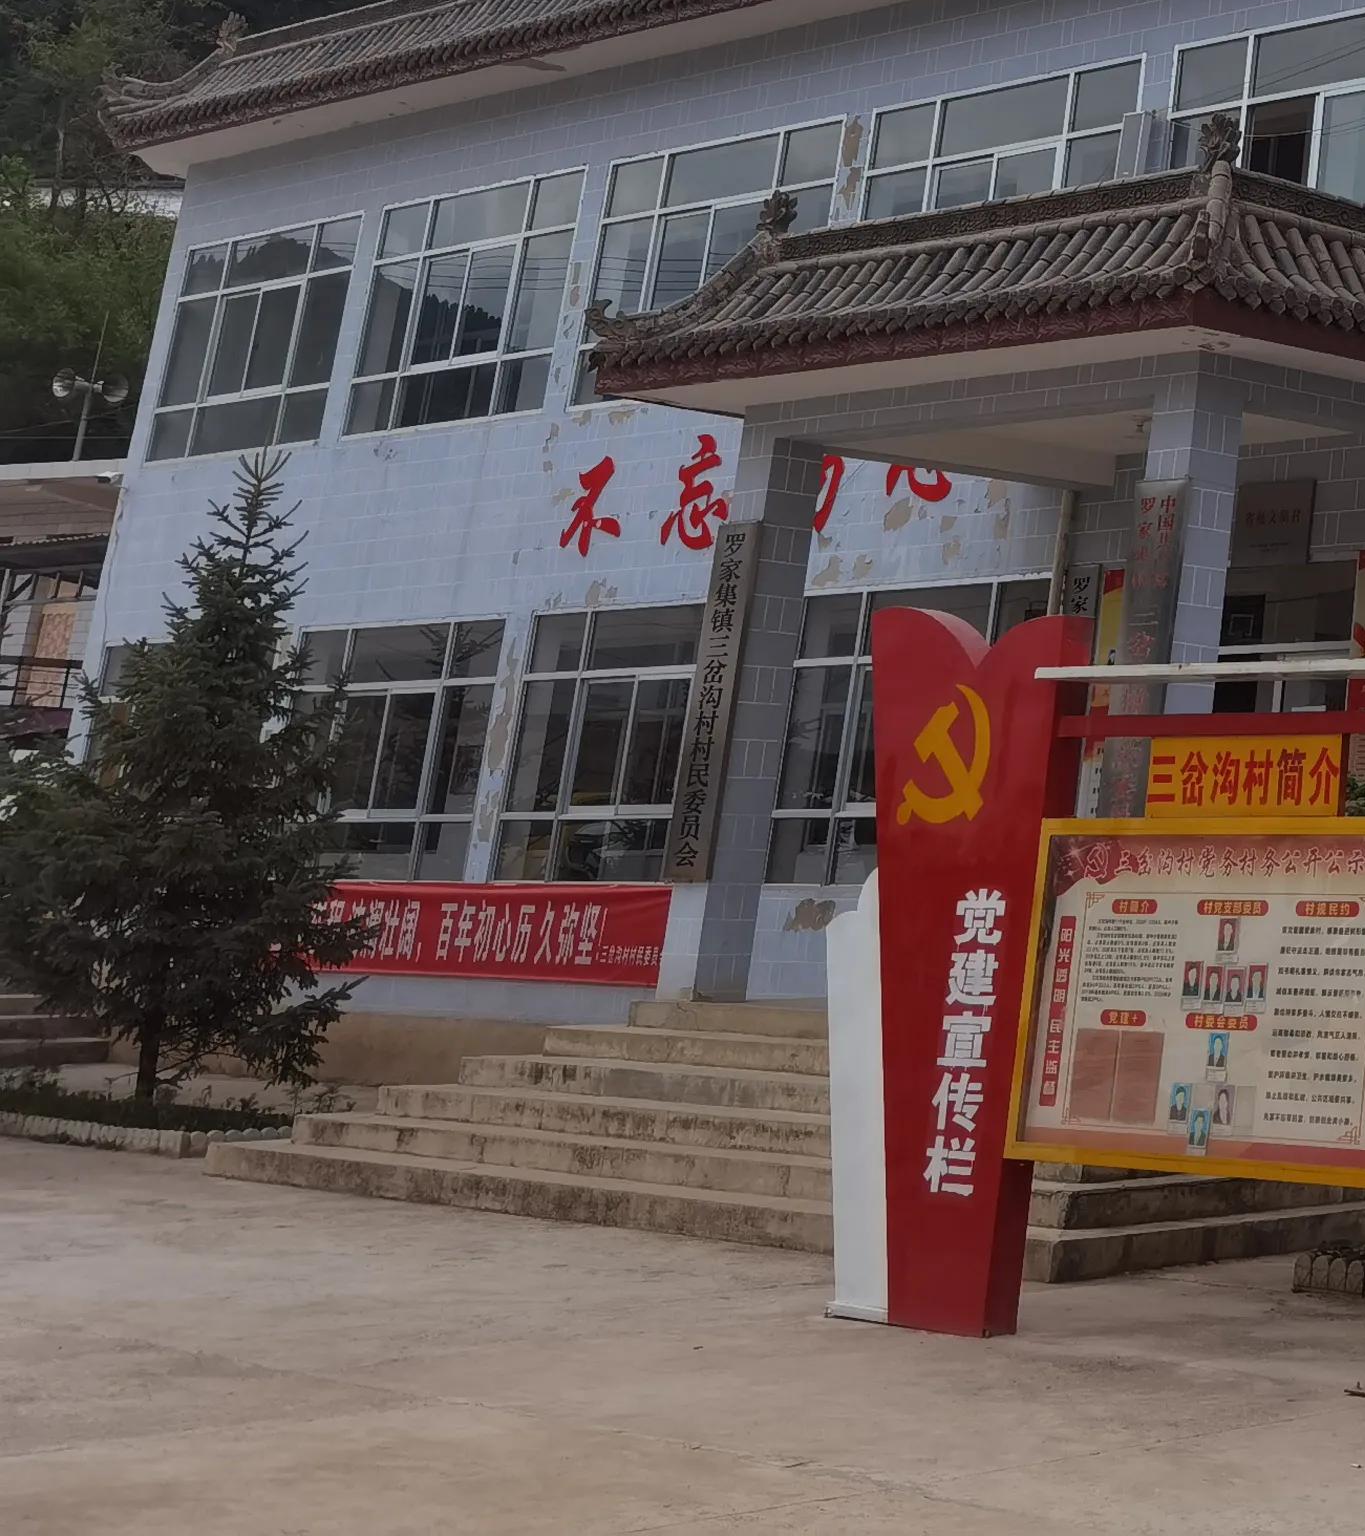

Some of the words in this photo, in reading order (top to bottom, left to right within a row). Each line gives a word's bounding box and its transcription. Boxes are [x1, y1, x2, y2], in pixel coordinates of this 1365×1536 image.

[672, 531, 747, 868] 罗家集镇三岔沟村村民委员会
[1147, 745, 1341, 809] 三岔沟村简介
[1203, 901, 1263, 915] 村党支部委员
[1304, 902, 1351, 916] 村规民约
[599, 945, 662, 966] 三岔沟村村民委员
[923, 888, 1007, 1198] 党建宣传栏
